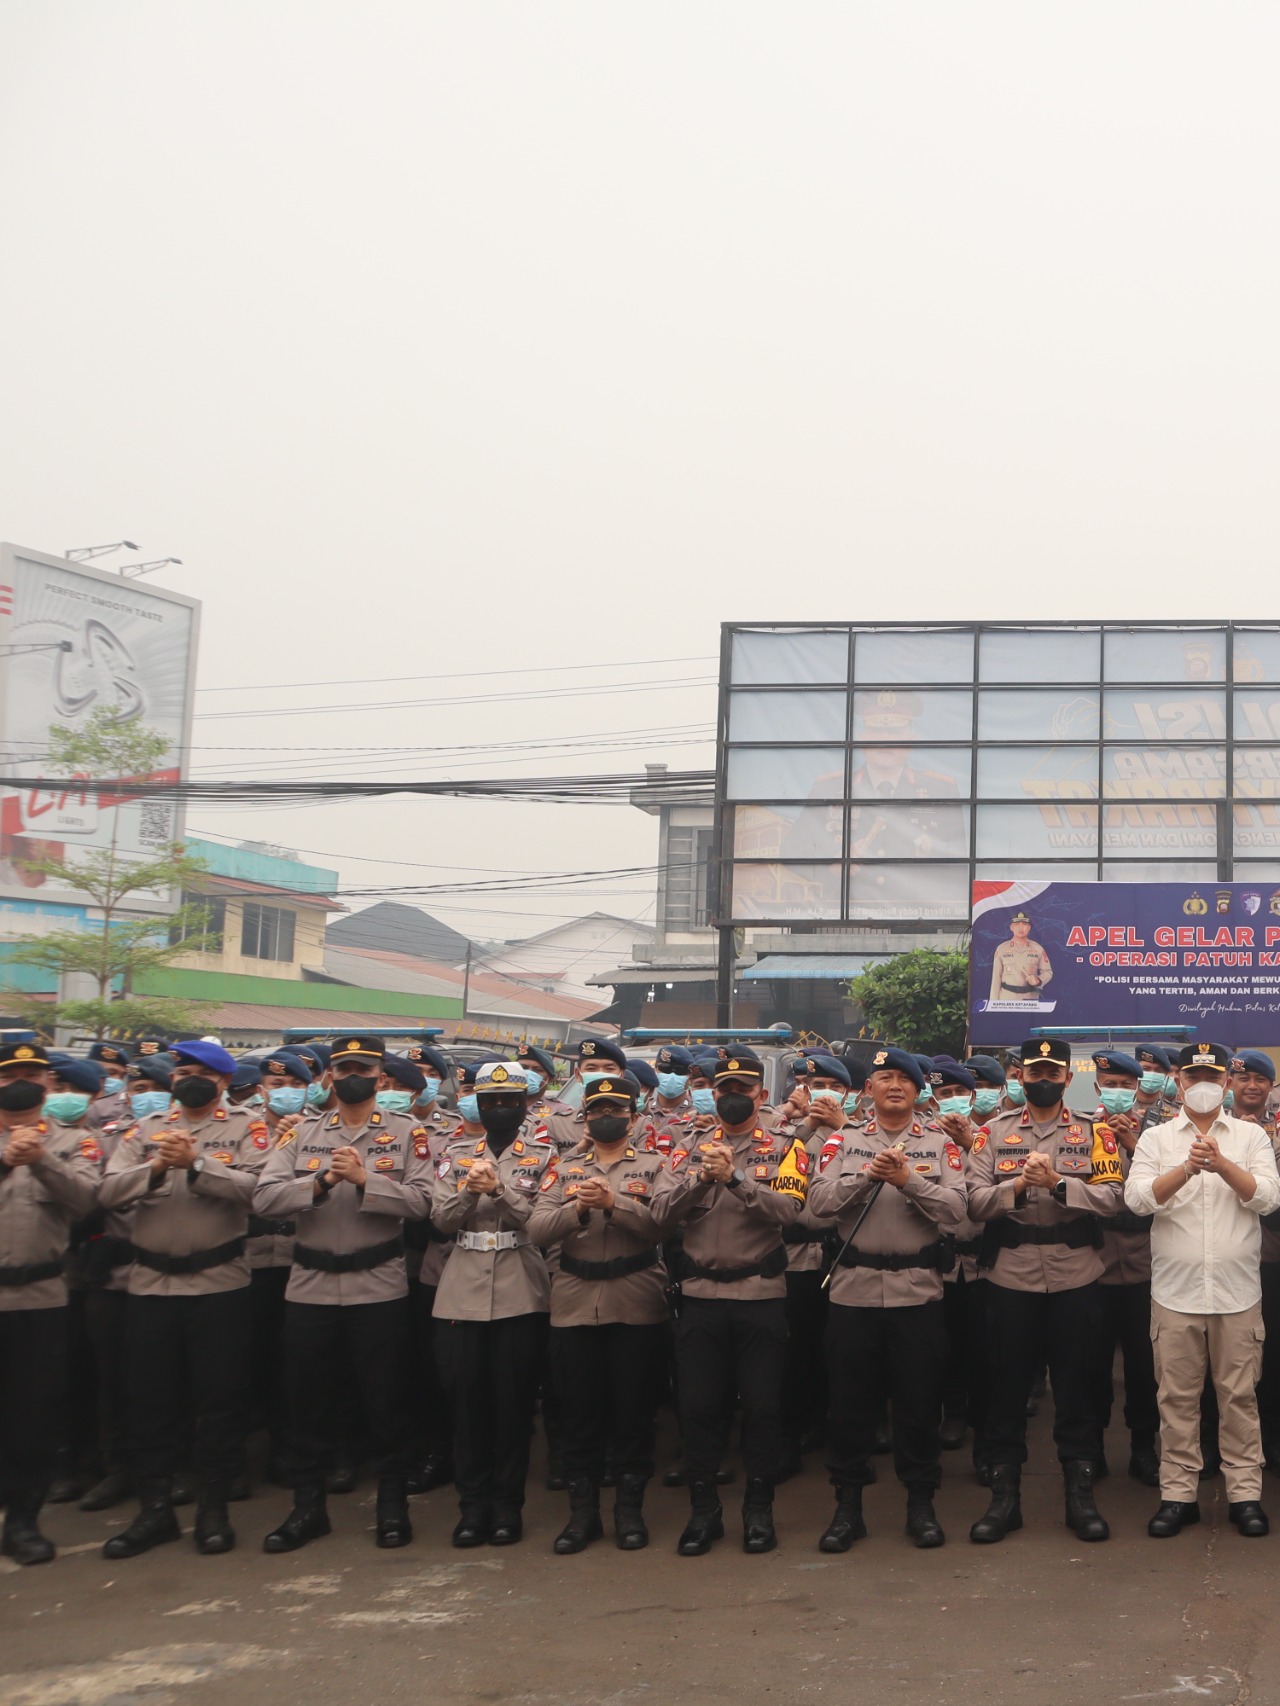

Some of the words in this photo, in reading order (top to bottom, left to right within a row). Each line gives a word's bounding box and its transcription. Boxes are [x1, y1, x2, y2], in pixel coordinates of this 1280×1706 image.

[45, 583, 89, 601] PERFECT
[91, 596, 133, 614] SMOOTH
[135, 608, 164, 623] TASTE
[1066, 926, 1144, 947] APEL
[1154, 926, 1255, 947] GELAR
[1089, 952, 1177, 967] OPERASI
[1182, 952, 1253, 966] PATUH
[1133, 975, 1180, 984] BERSAMA
[1182, 975, 1249, 984] MASYARAKAT
[1129, 987, 1157, 996] YANG
[1159, 987, 1197, 997] TERTIB,
[1199, 987, 1228, 995] AMAN
[1231, 987, 1252, 995] DAN
[203, 1139, 241, 1149] POLRI
[367, 1144, 402, 1156] POLRI
[905, 1151, 937, 1159] POLRI
[1059, 1147, 1089, 1156] POLRI
[747, 1154, 778, 1165] POLRI
